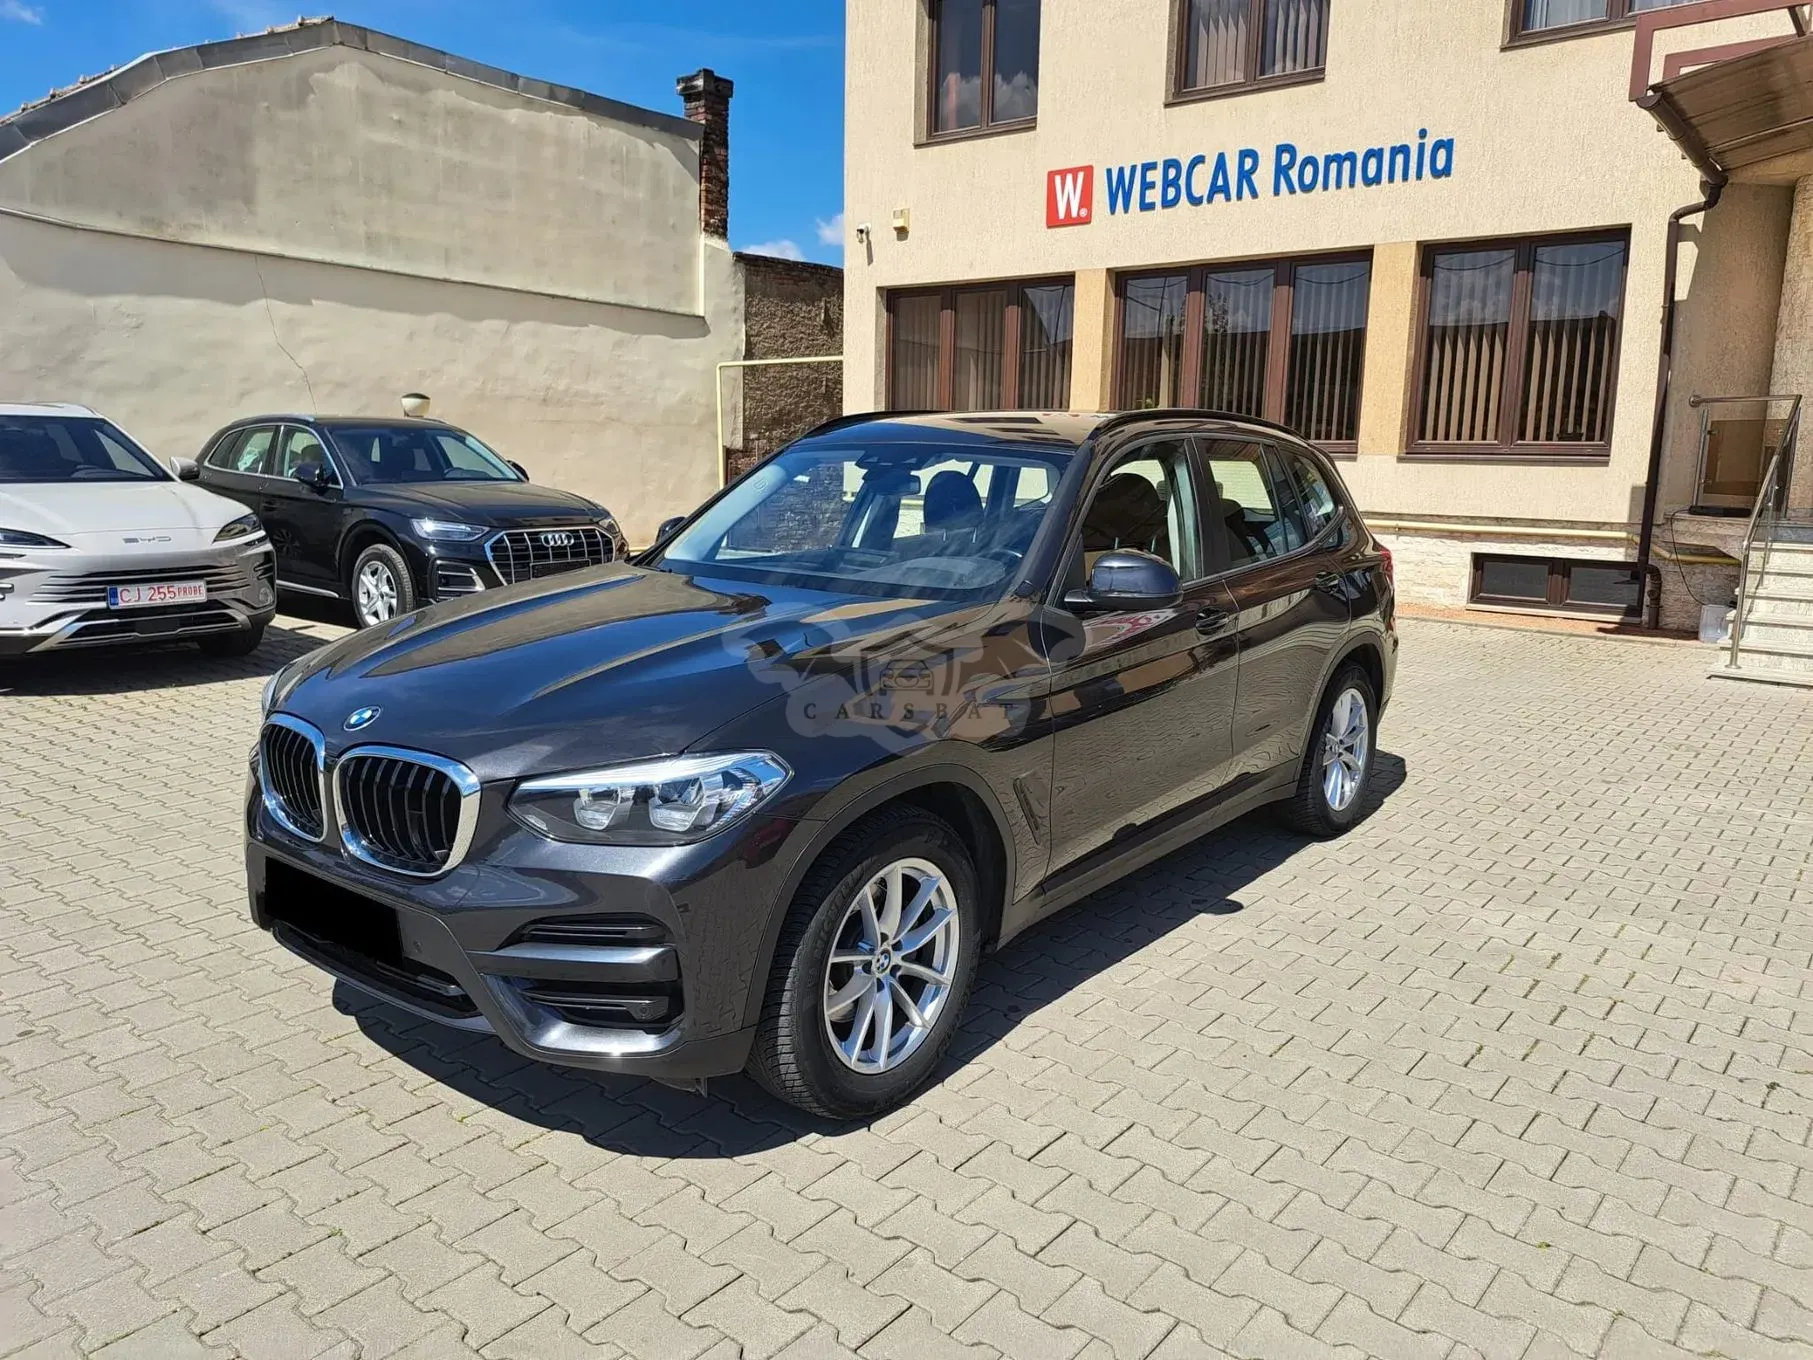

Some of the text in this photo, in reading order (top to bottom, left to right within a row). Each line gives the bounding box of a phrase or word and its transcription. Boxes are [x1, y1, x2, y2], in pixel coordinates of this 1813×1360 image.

[1106, 128, 1455, 215] WEBCAR Romania
[120, 584, 203, 603] CJ 255 PROBE
